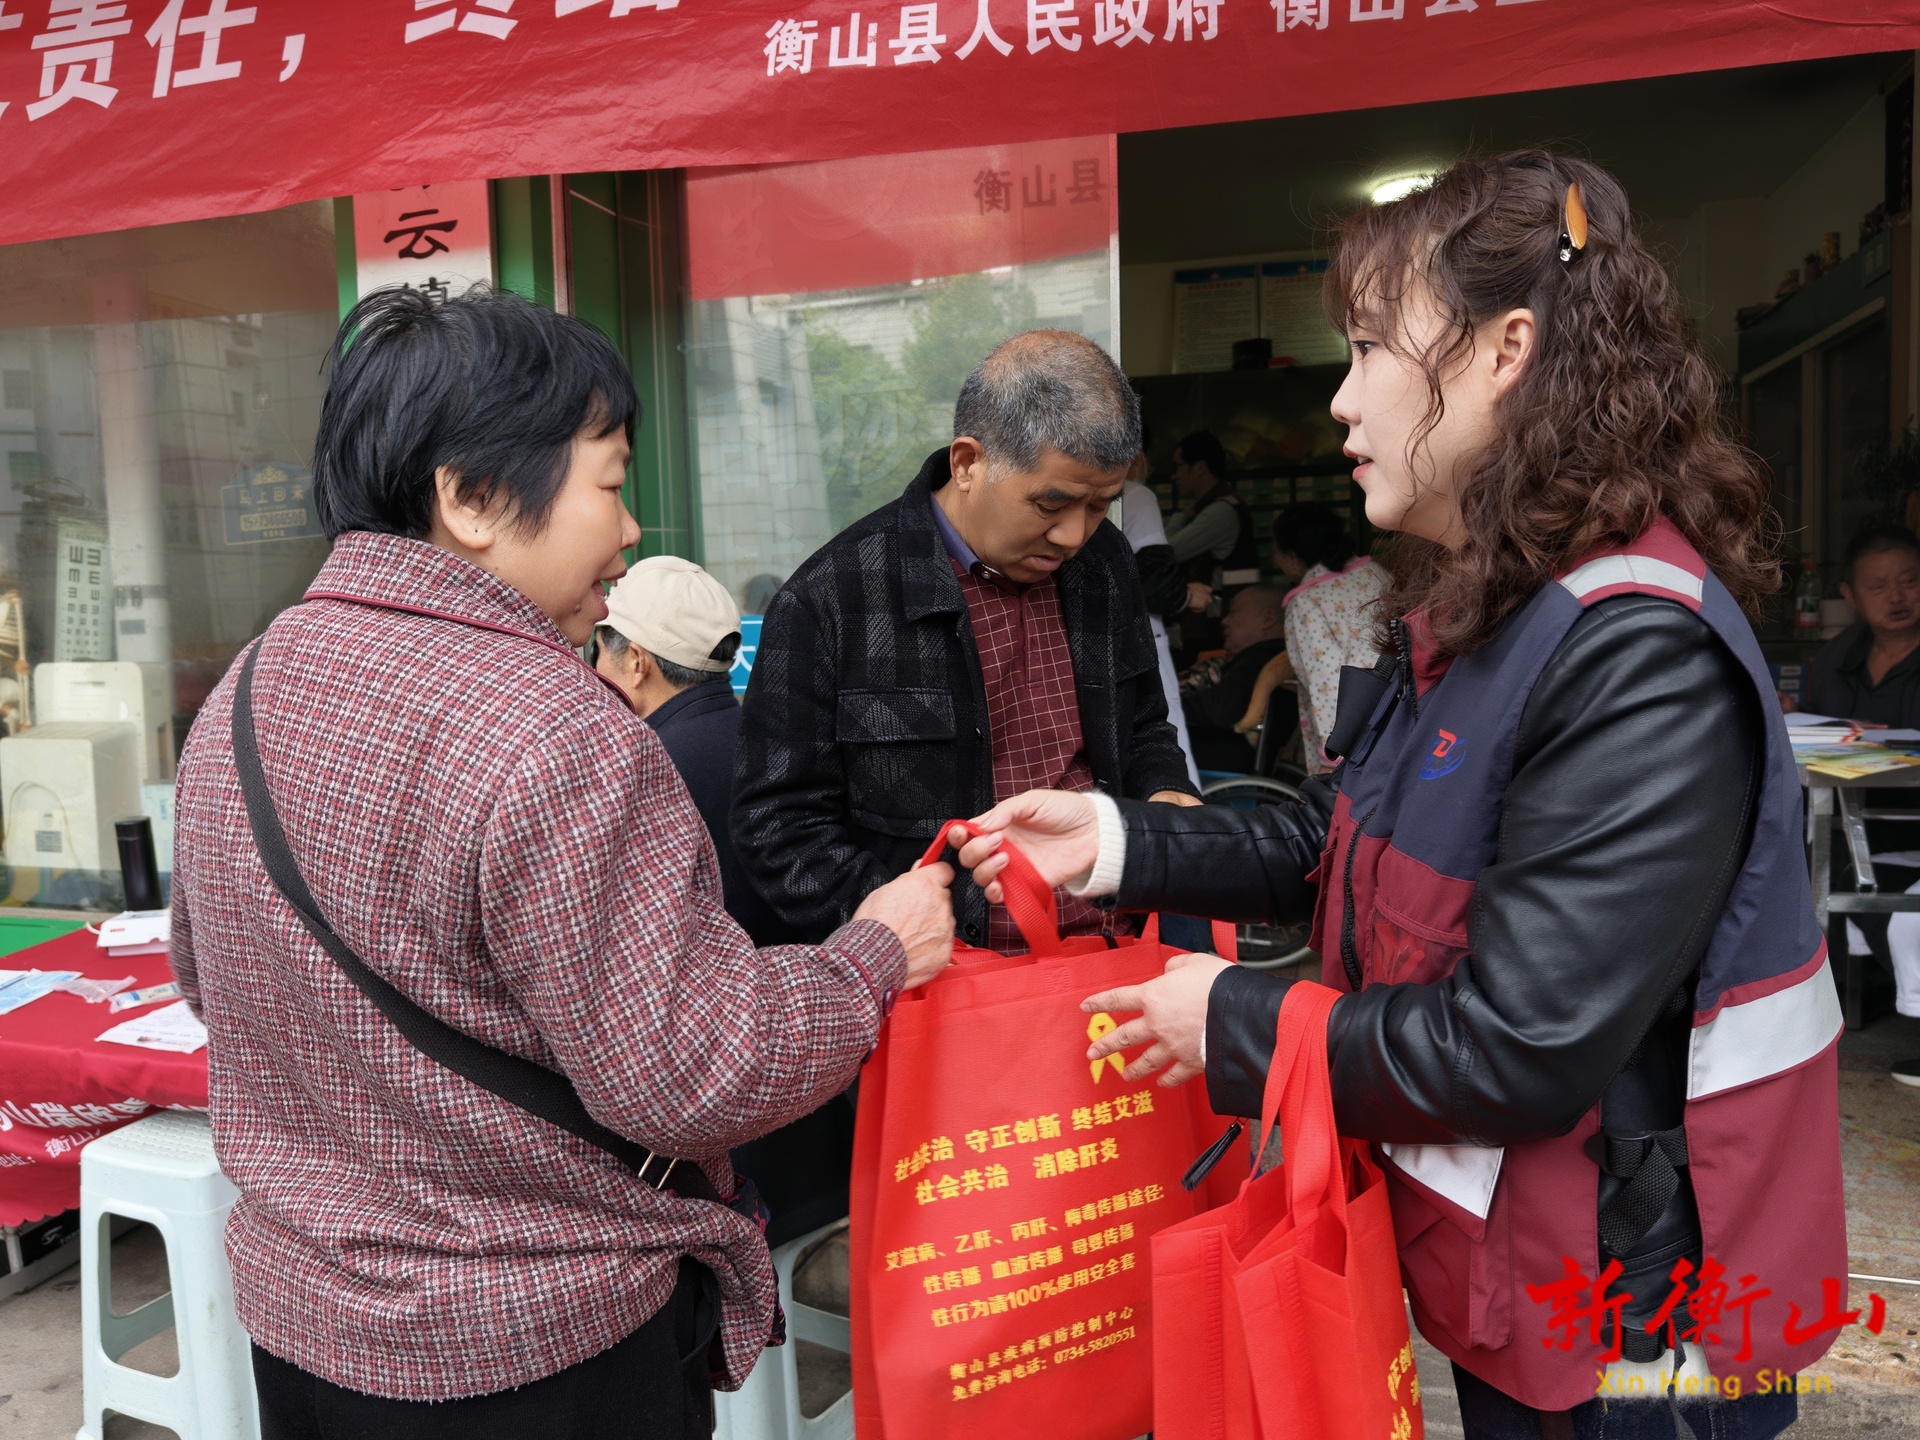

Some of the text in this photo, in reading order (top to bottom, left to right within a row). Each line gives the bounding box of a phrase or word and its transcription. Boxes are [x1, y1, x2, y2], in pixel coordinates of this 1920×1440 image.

[763, 0, 1225, 76] 衡山县人民政府
[973, 158, 1108, 215] 衡山县
[964, 1113, 1062, 1153] 守正创新
[1071, 1090, 1154, 1130] 终结艾滋
[915, 1137, 1120, 1205] 社会共治 消除肝炎
[923, 1222, 1134, 1294] 性传播 血液传播 母婴传播
[931, 1253, 1135, 1328] 性行为请100%使用安全套
[949, 1306, 1134, 1380] 衡山县疾病预防控制中心
[952, 1326, 1136, 1401] 免费咨询电话： 0734-5820551
